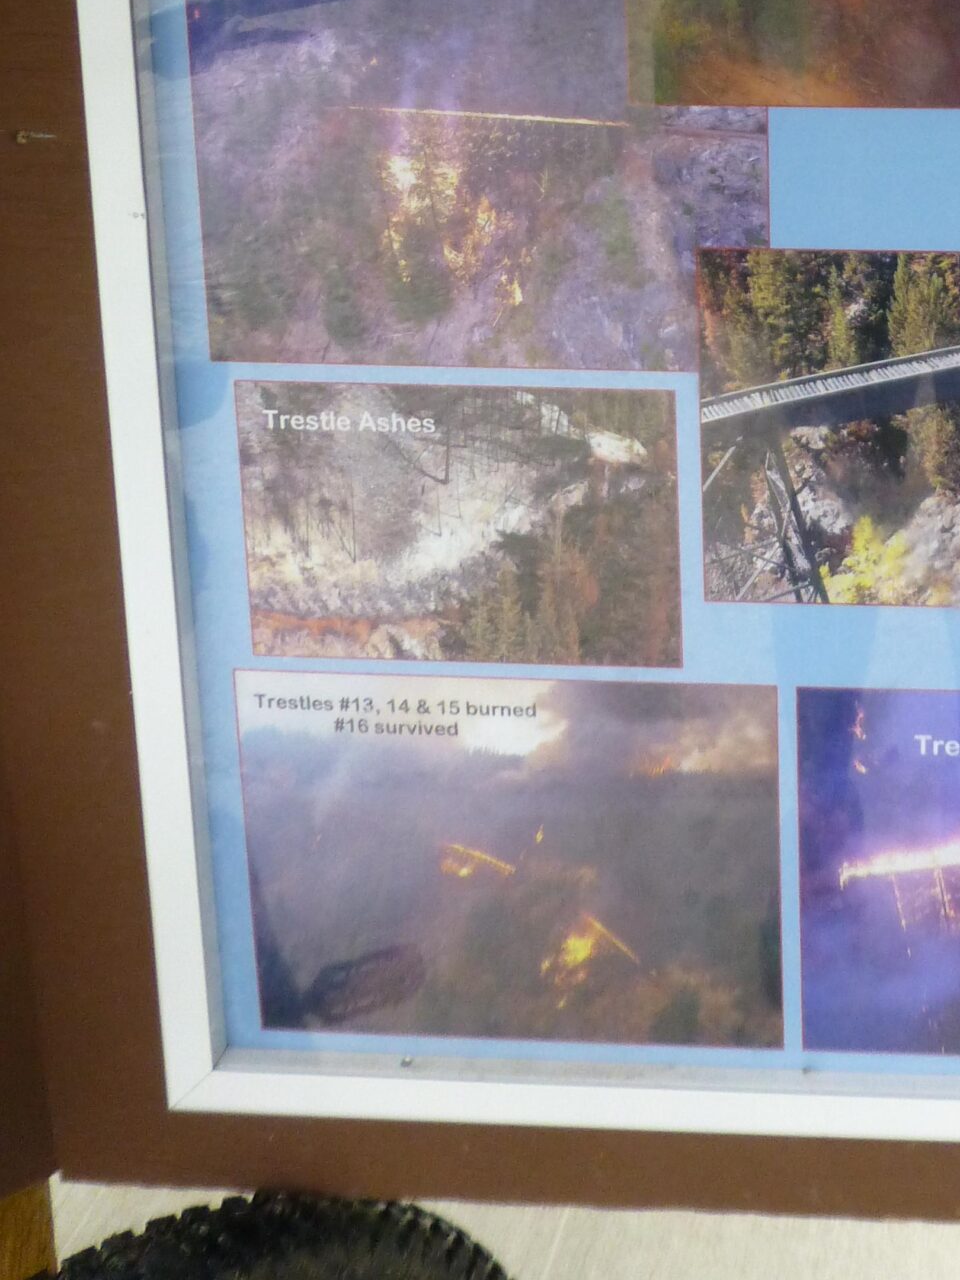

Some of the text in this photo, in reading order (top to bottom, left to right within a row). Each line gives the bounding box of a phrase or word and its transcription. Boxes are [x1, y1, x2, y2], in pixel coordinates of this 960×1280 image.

[262, 409, 436, 434] Trestle Ashes
[253, 693, 538, 718] Trestles #13, 14 & 15 burned
[333, 717, 459, 737] #16 survived
